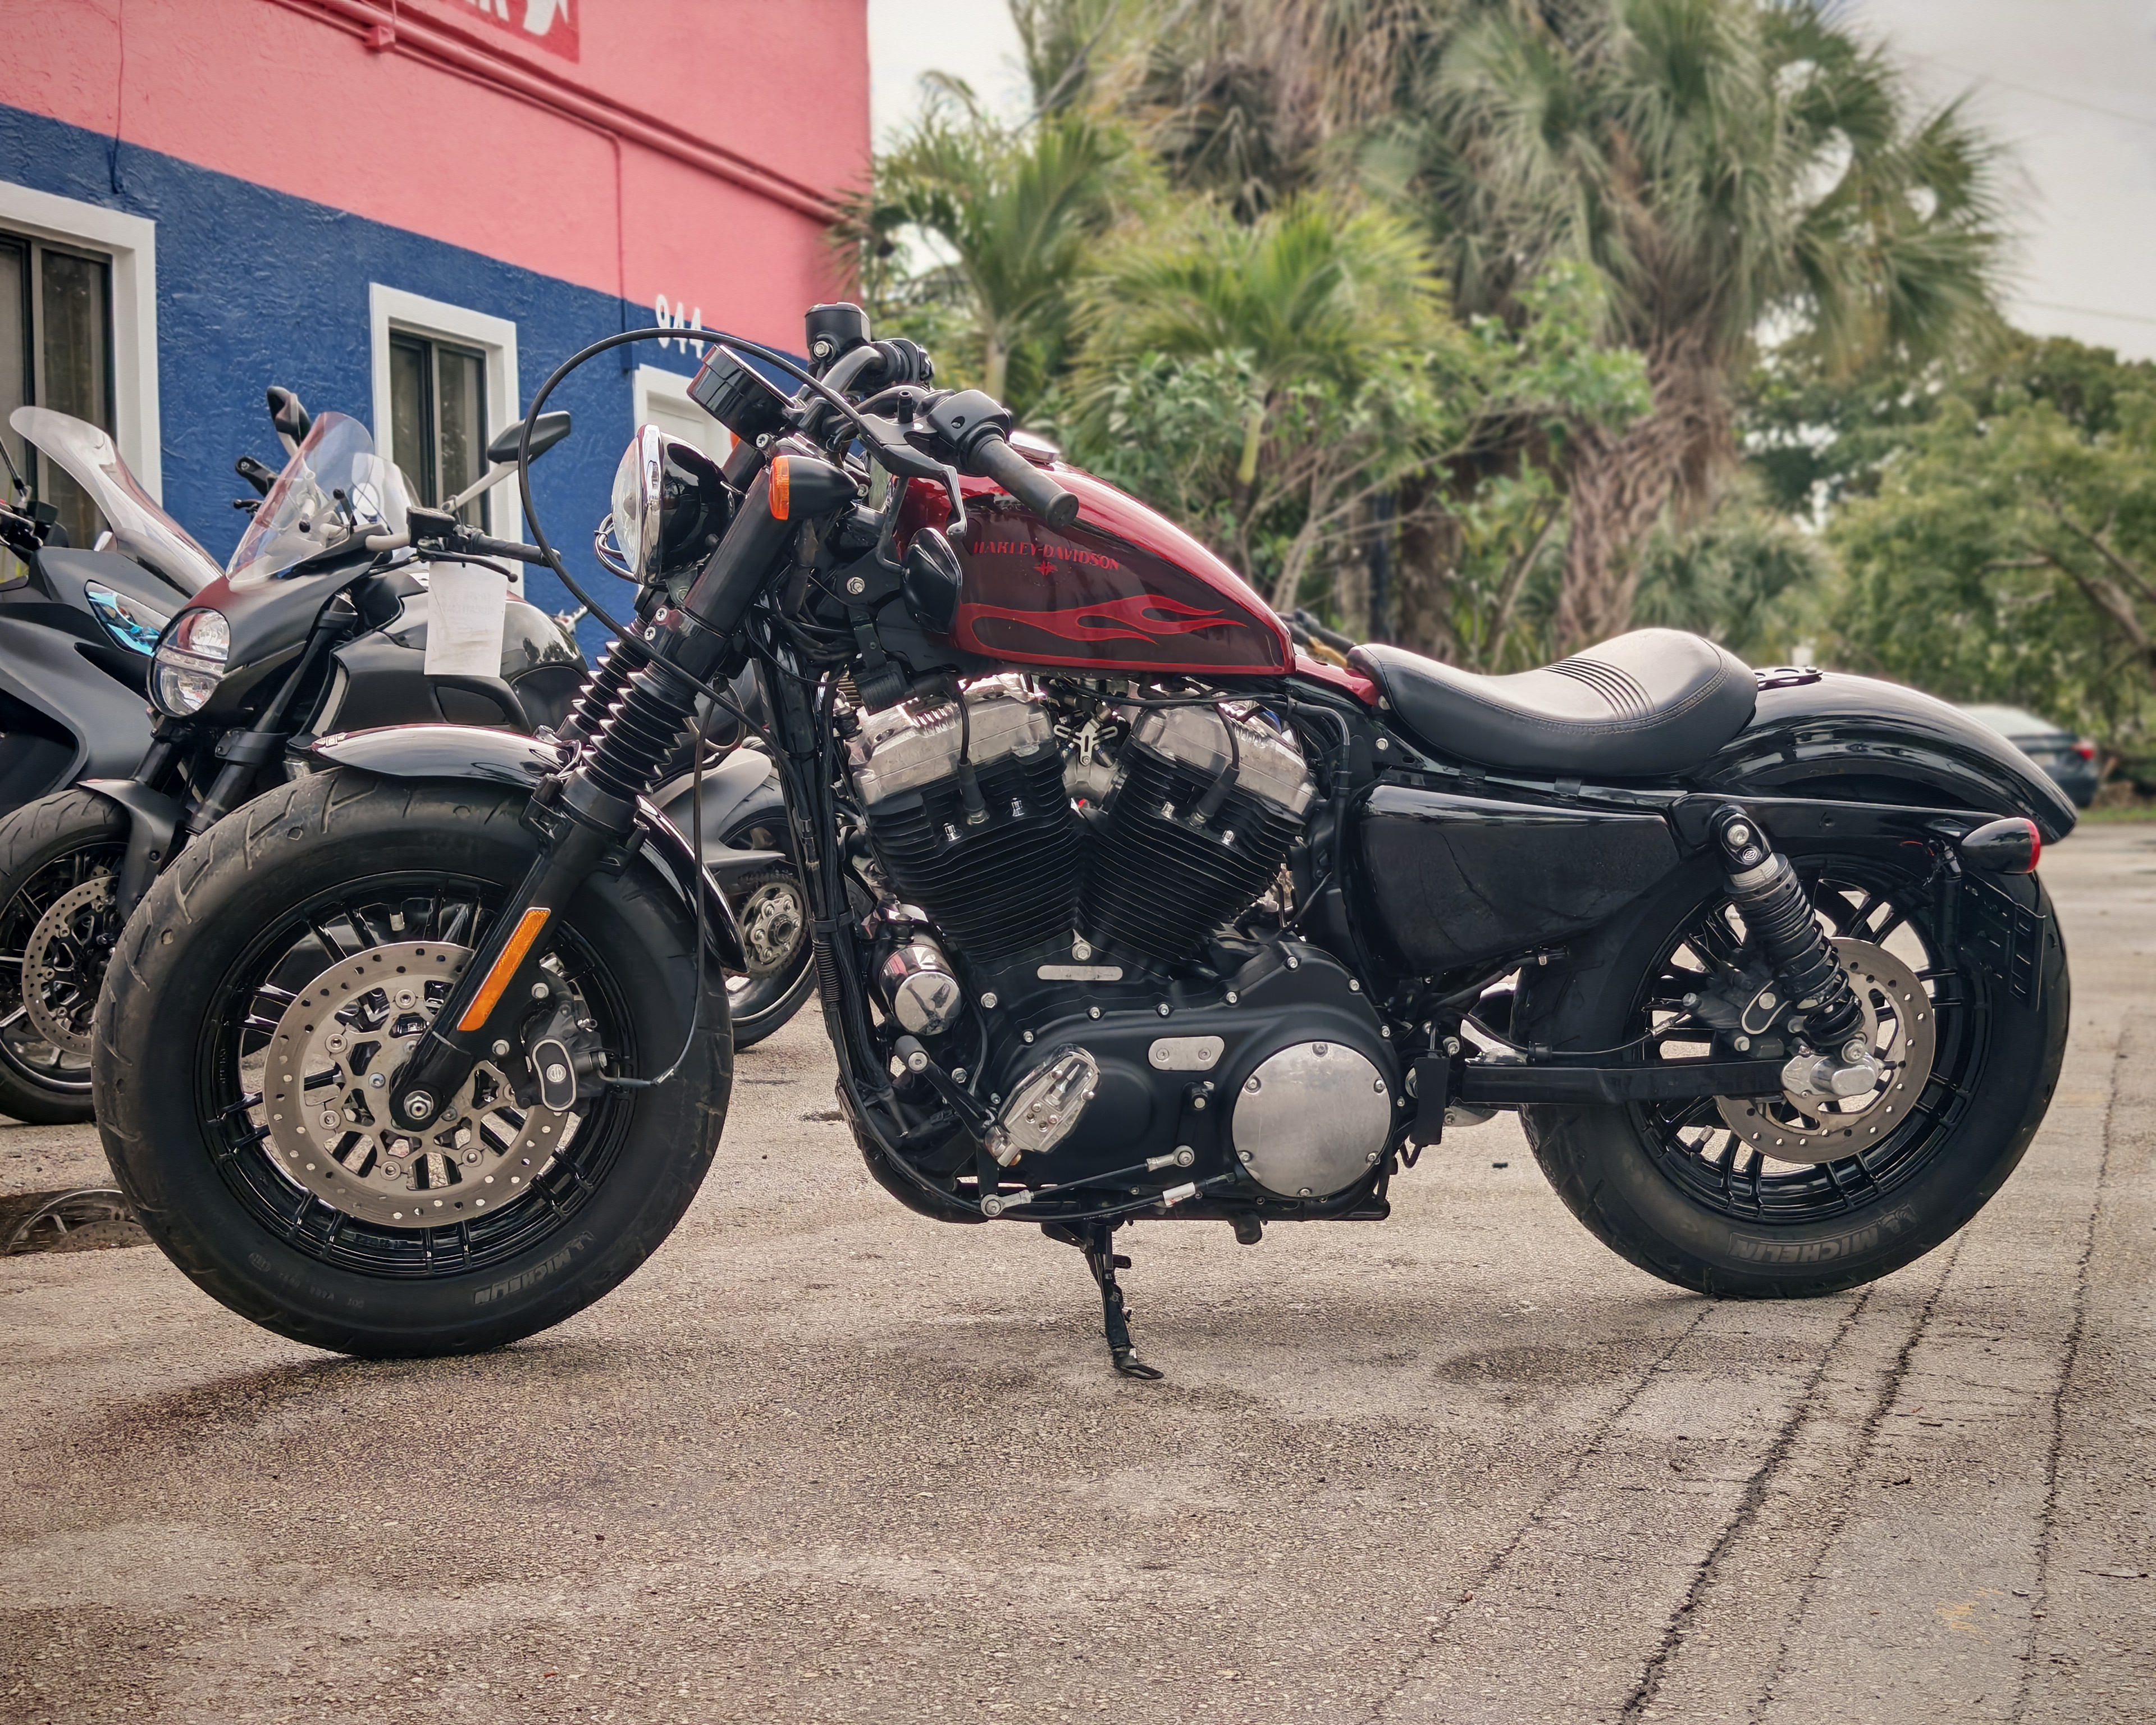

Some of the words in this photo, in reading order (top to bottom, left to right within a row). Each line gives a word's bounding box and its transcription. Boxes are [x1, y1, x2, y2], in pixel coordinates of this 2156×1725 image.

[655, 294, 704, 359] 944
[1729, 1227, 1879, 1263] MICHELIN
[474, 1248, 572, 1305] MICHELIN
